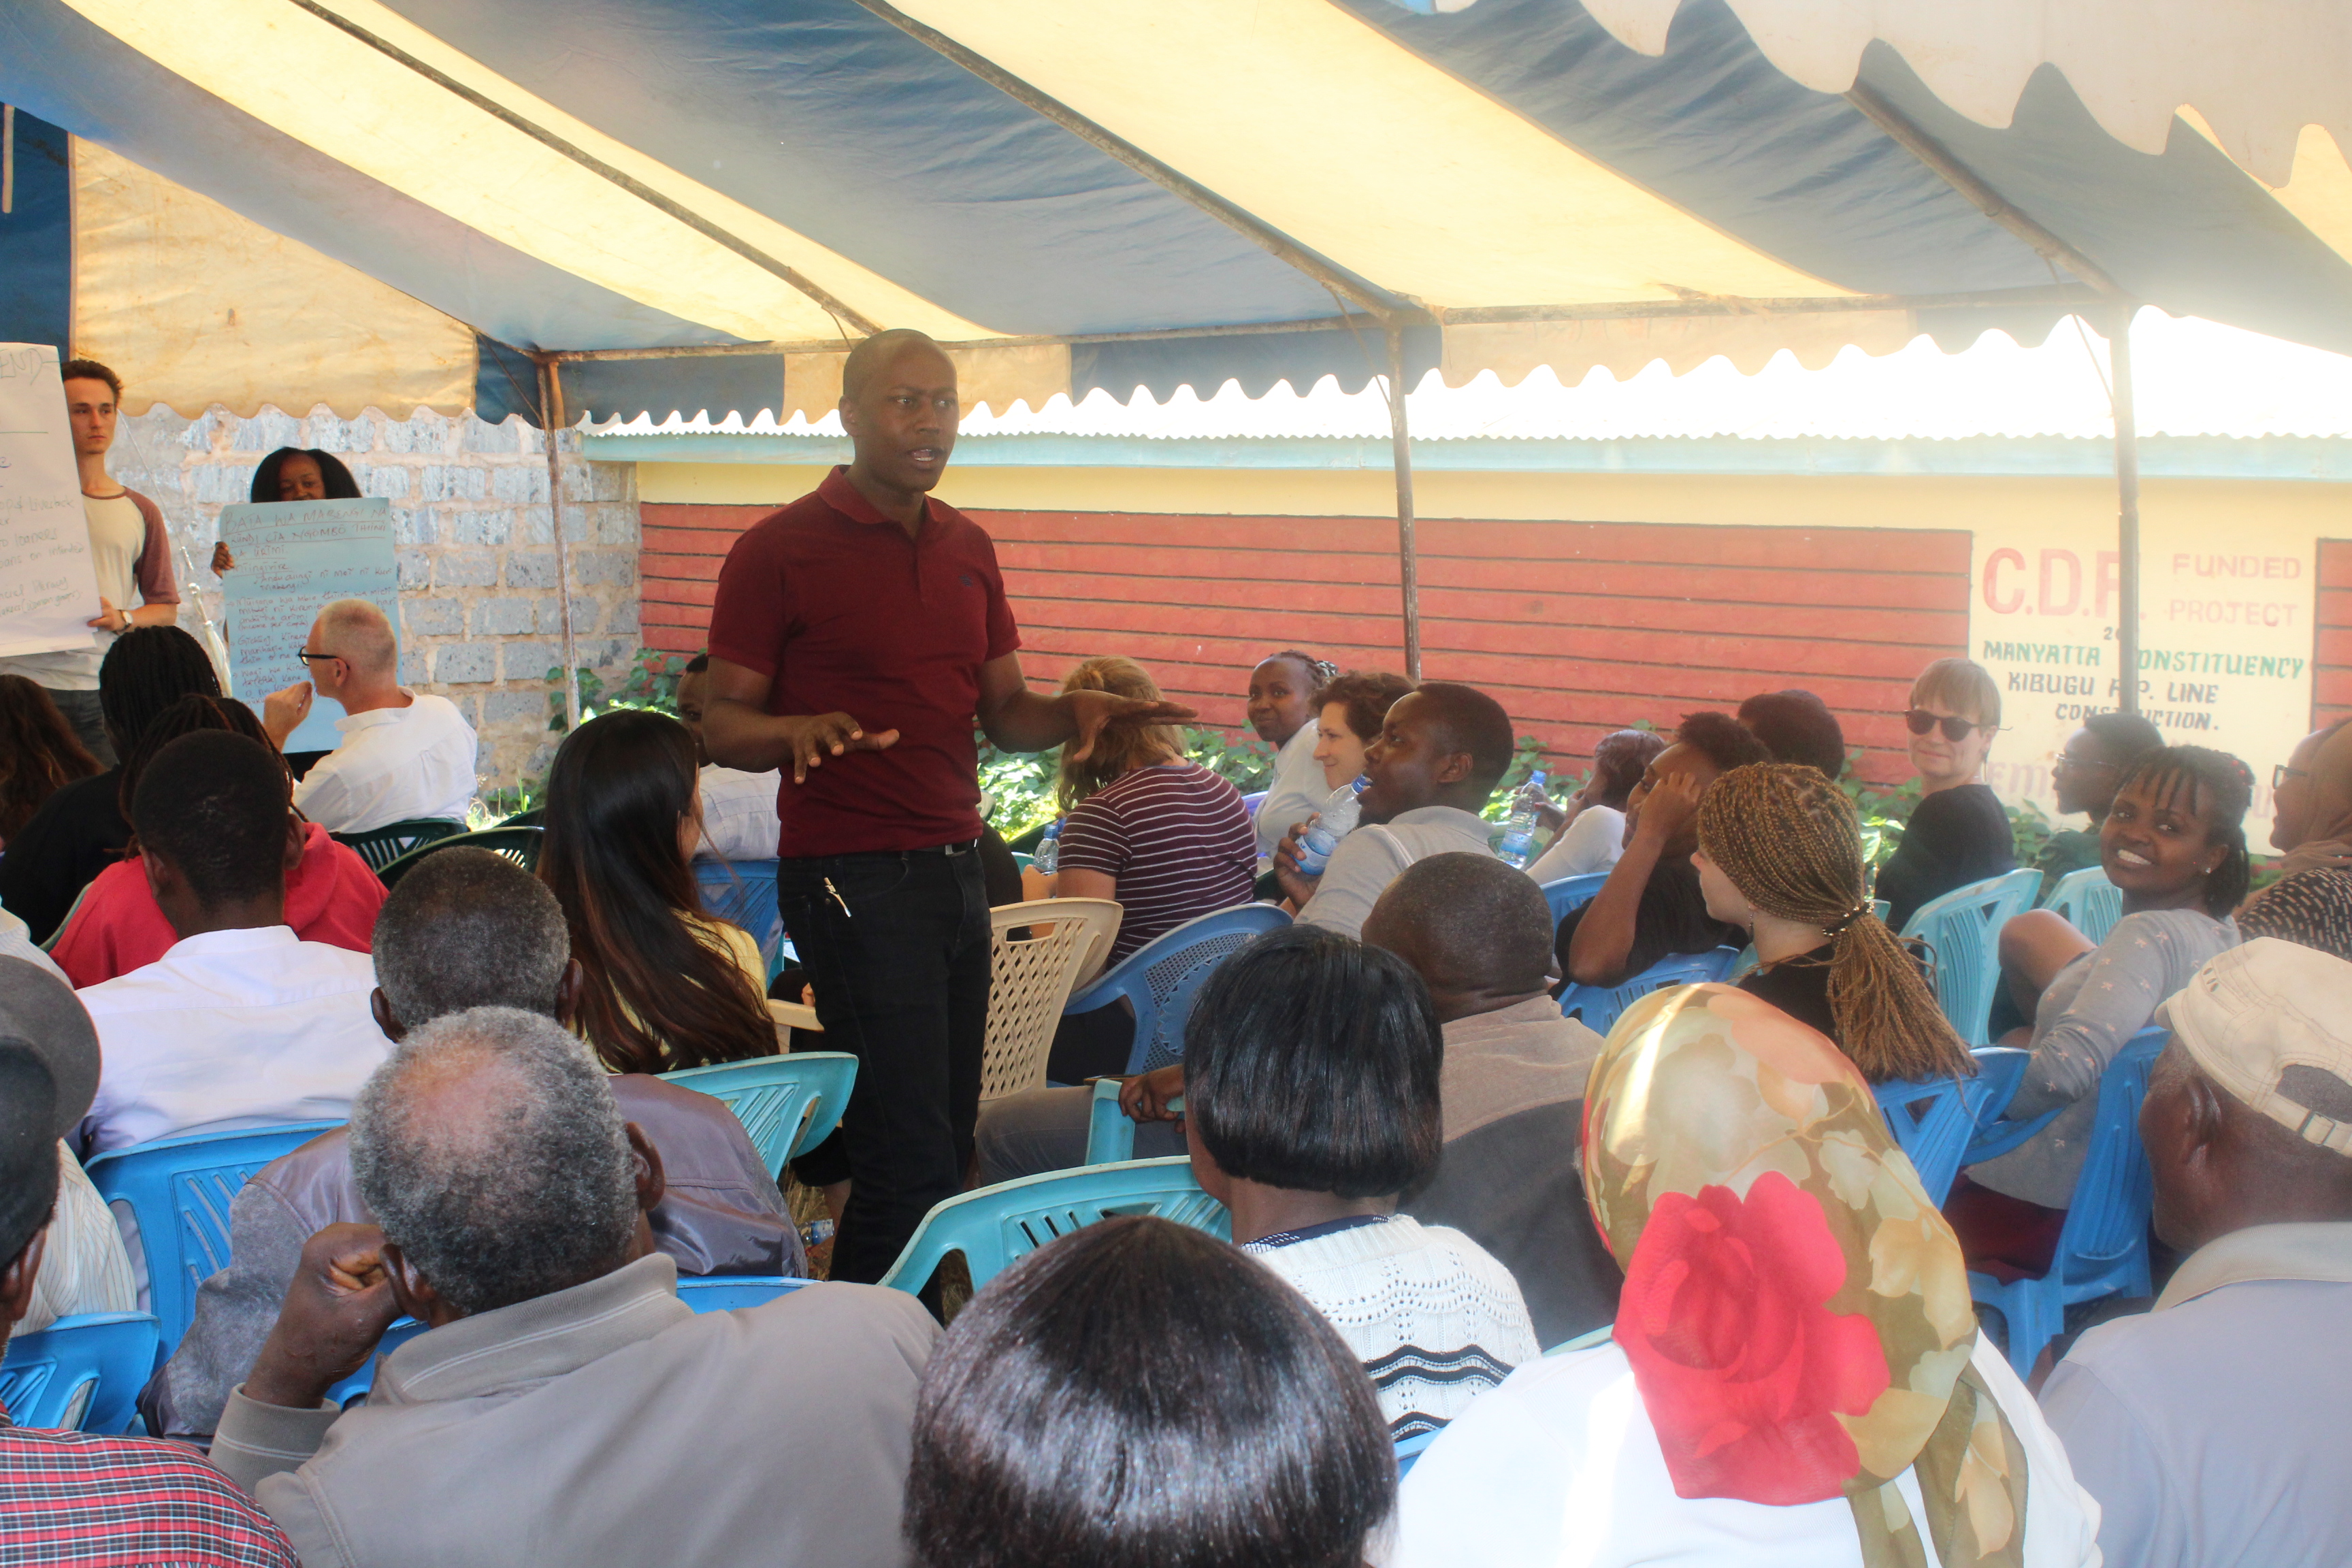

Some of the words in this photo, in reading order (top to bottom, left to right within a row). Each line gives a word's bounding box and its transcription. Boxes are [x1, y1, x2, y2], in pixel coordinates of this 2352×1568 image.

[371, 506, 387, 518] NA
[2172, 553, 2302, 579] FUNDED
[2169, 599, 2298, 627] PROJECT
[1983, 640, 2100, 666] MANYATTA
[2138, 649, 2304, 679] ONSTITUENCY
[2008, 671, 2095, 696] KIBUGU
[2167, 681, 2219, 704] LINE
